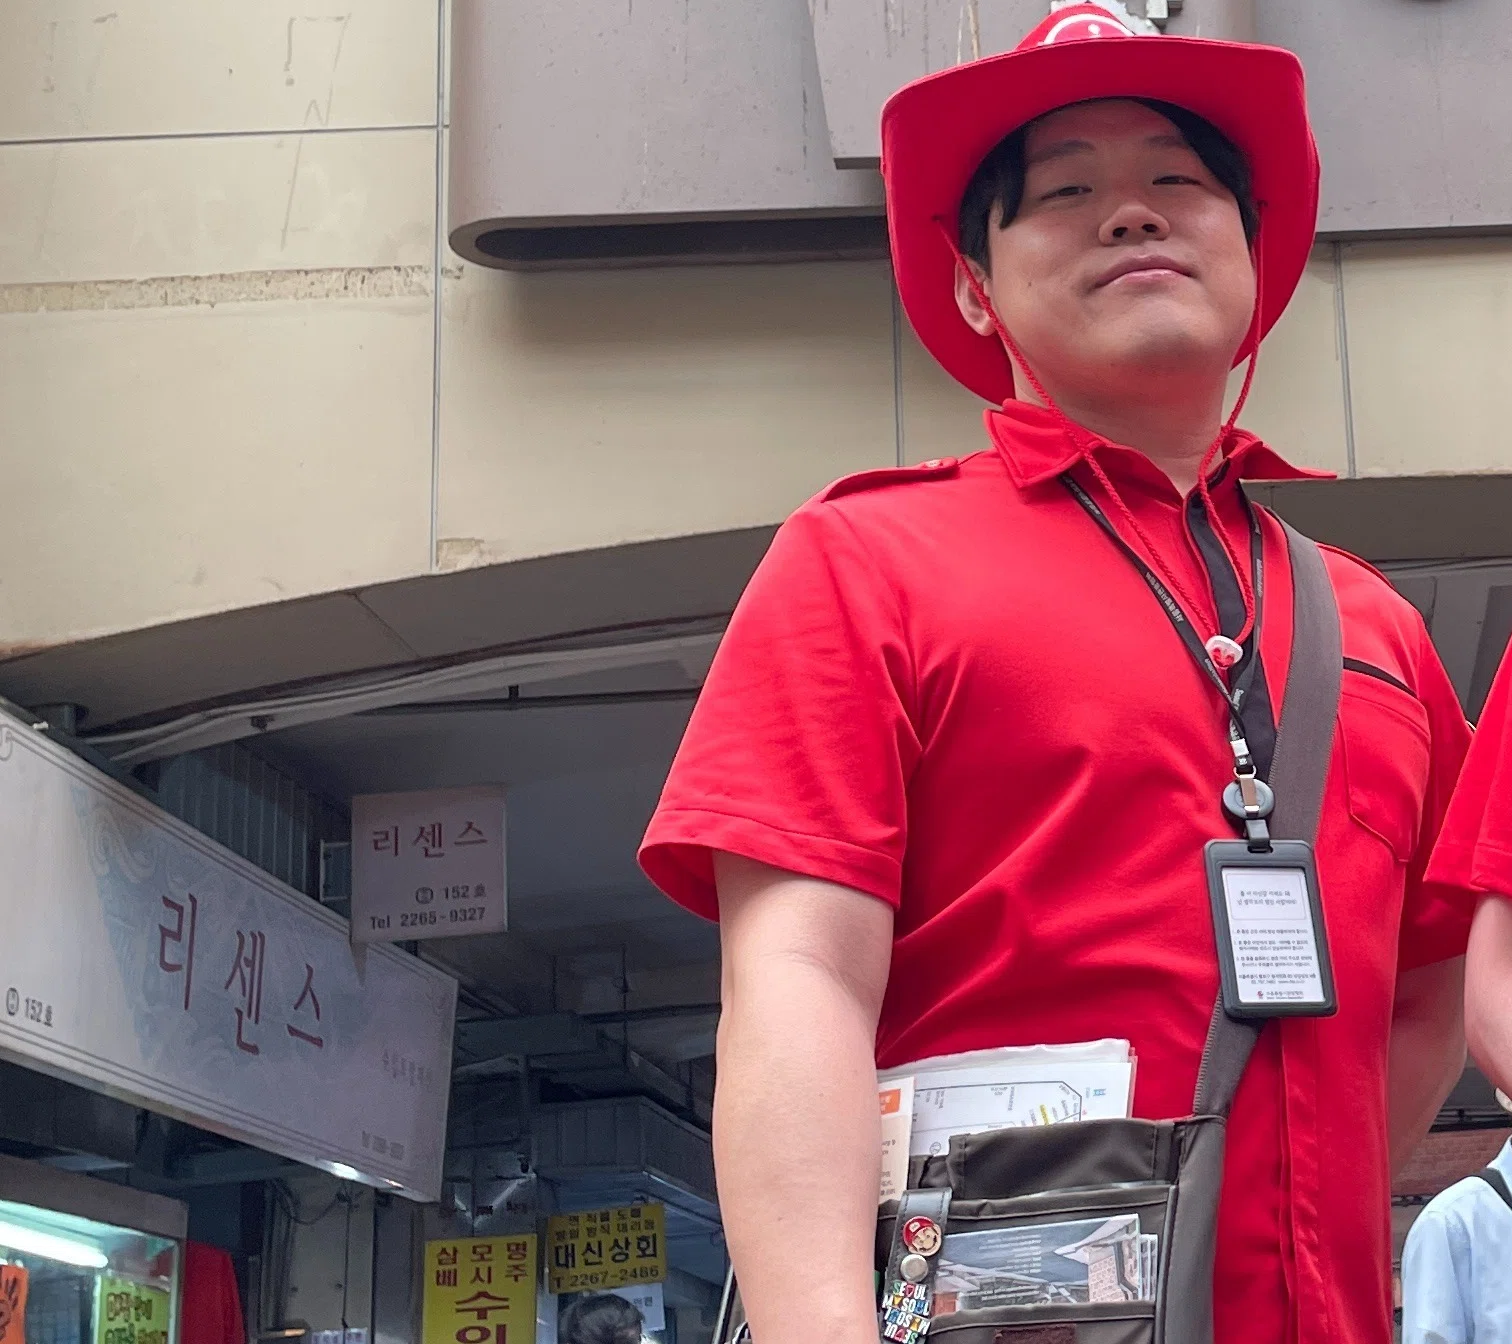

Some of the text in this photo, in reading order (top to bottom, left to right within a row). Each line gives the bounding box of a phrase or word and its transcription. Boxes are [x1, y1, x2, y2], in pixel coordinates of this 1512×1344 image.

[372, 821, 489, 858] 리센스
[158, 893, 324, 1056] 리센스
[554, 1233, 658, 1269] 대신상회
